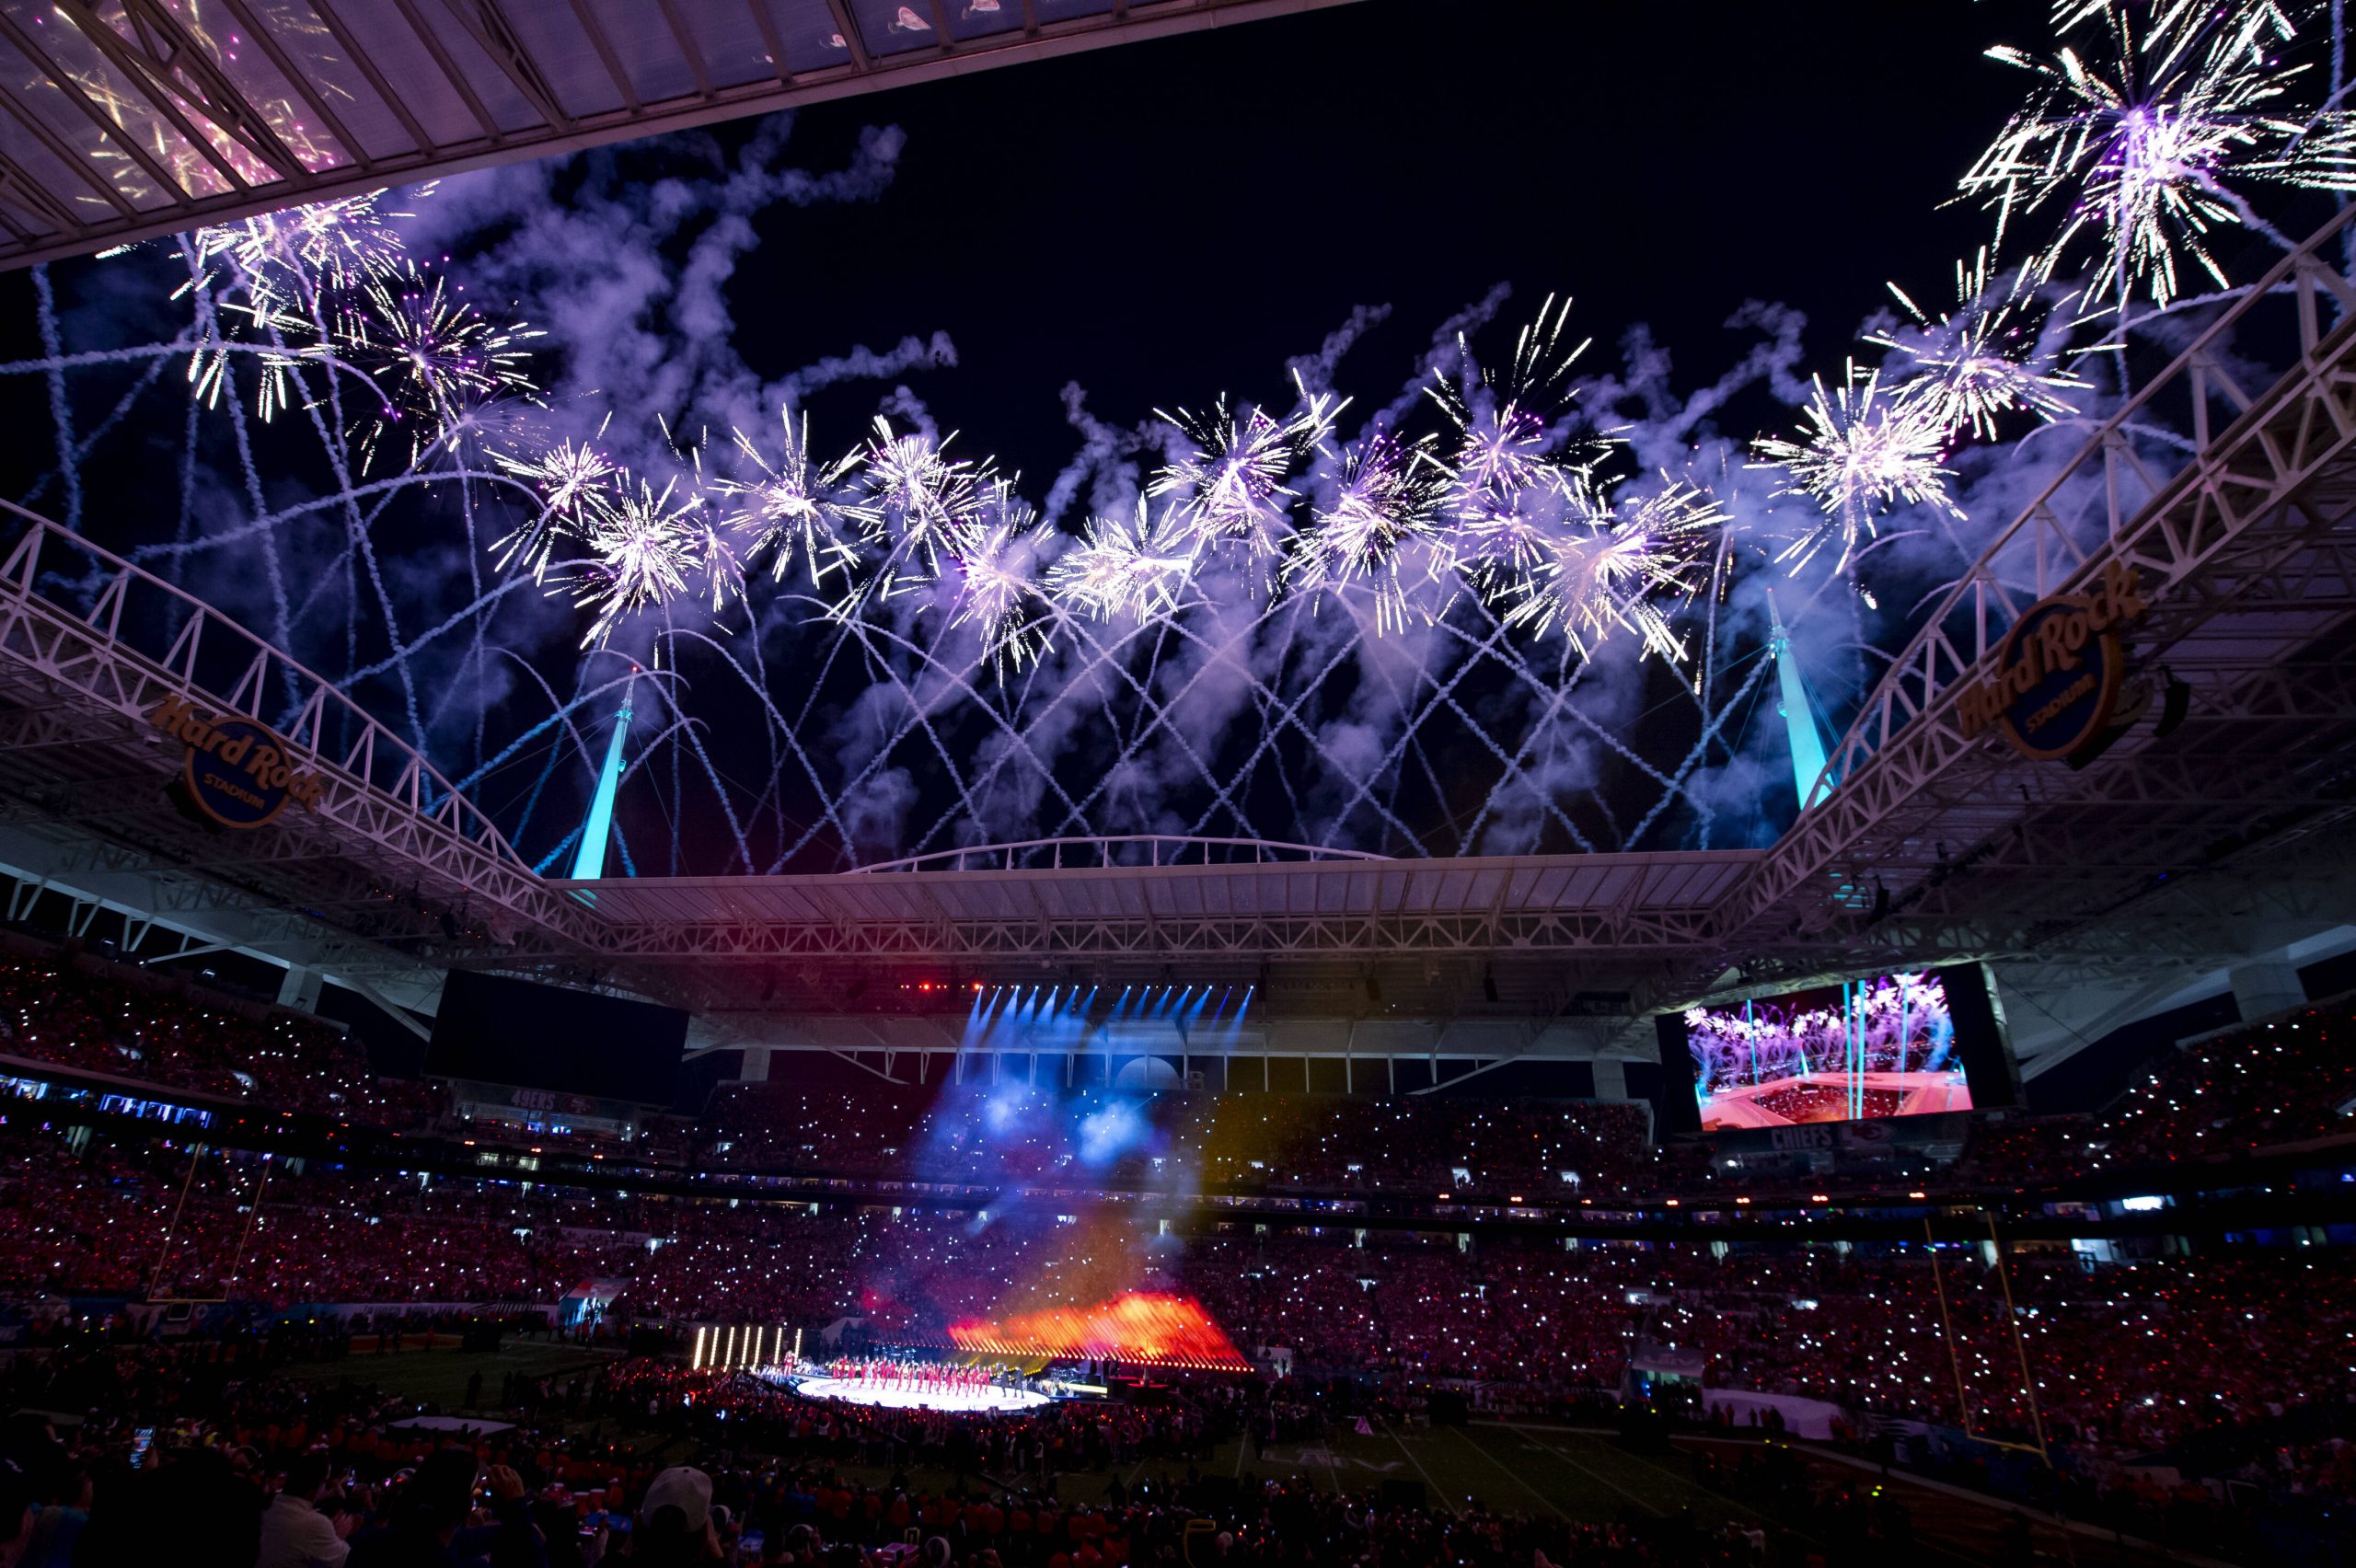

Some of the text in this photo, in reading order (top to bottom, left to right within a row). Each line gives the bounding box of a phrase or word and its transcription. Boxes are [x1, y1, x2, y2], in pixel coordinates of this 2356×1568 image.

[1957, 560, 2148, 740] Hard Rock
[2026, 674, 2097, 734] STADIUM
[152, 694, 323, 814] Hard Rock
[203, 773, 266, 810] STADIUM
[512, 1089, 556, 1110] 49ERS
[1771, 1124, 1833, 1150] CHIEFS
